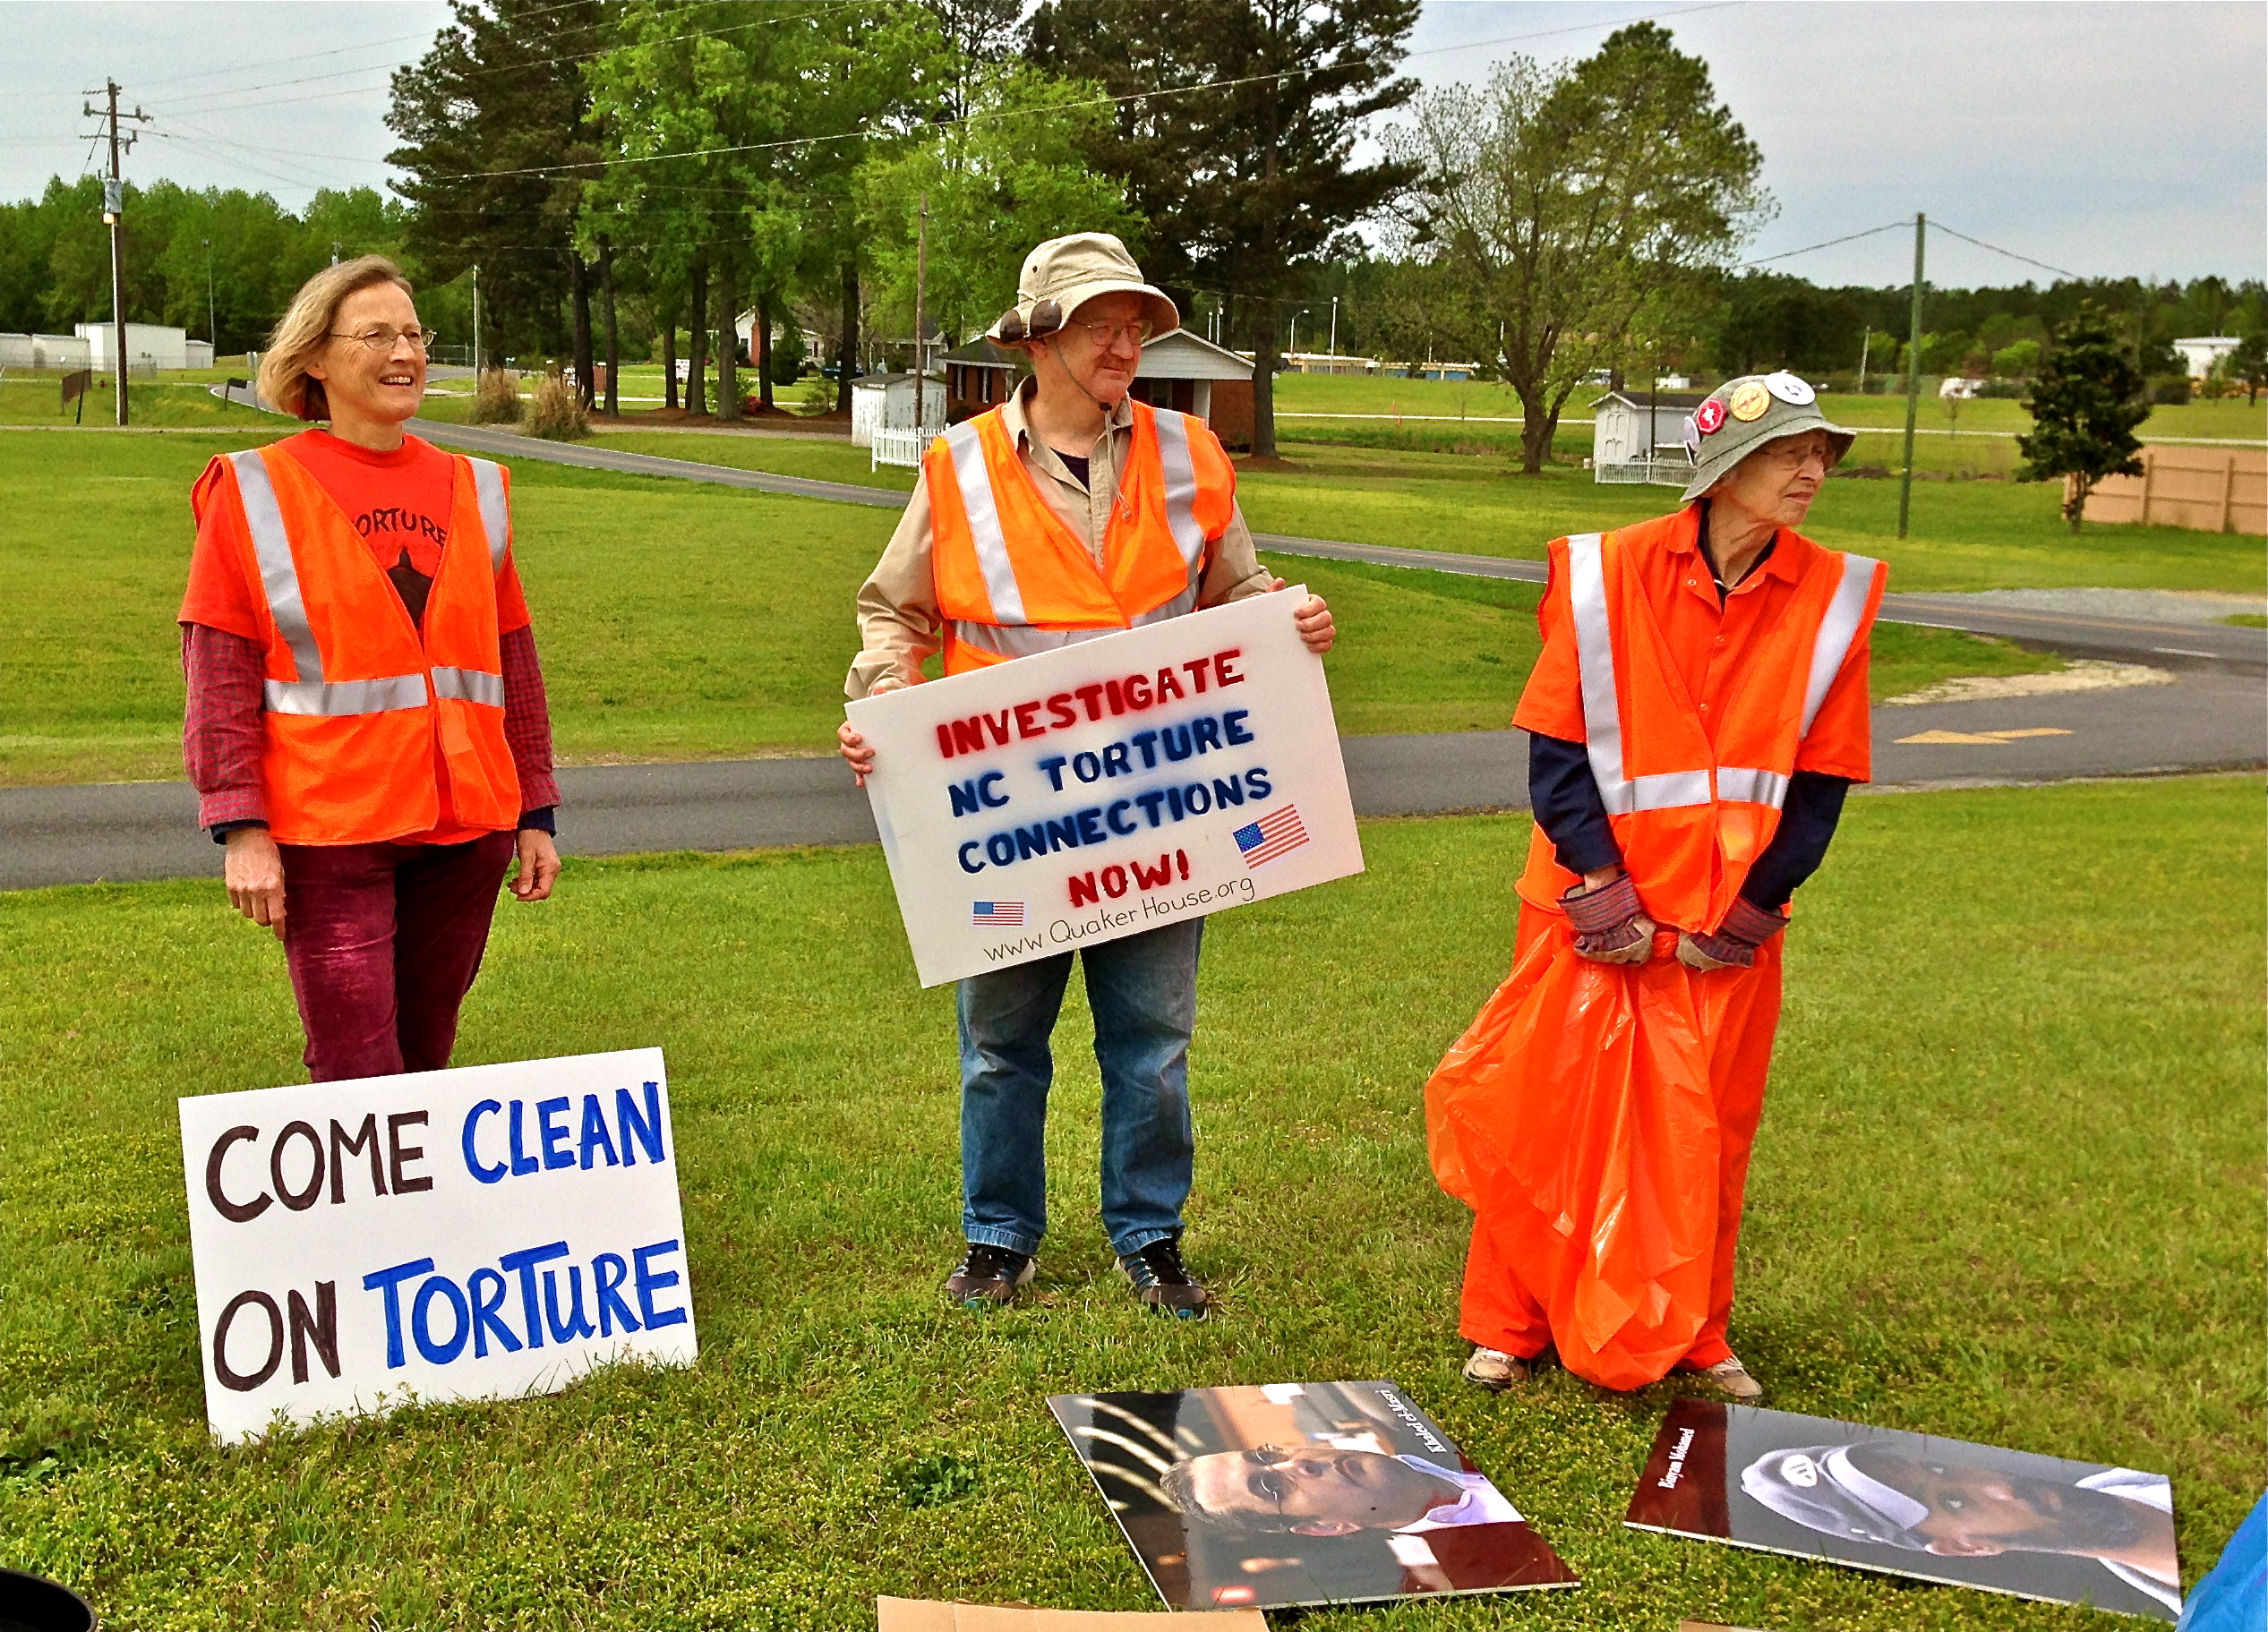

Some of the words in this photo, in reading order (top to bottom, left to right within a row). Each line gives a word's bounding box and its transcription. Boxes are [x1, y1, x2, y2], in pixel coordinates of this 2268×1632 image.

[353, 508, 447, 548] ORTURE
[937, 649, 1245, 758] INVESTIGATE
[948, 773, 1010, 818] NC
[1040, 710, 1254, 792] TORTURE
[958, 768, 1272, 874] CONNECTIONS
[1068, 849, 1190, 908] NOW!
[206, 1110, 433, 1223] COME
[462, 1081, 665, 1183] CLEAN
[213, 1280, 341, 1391] ON
[1406, 1422, 1447, 1453] Khaled
